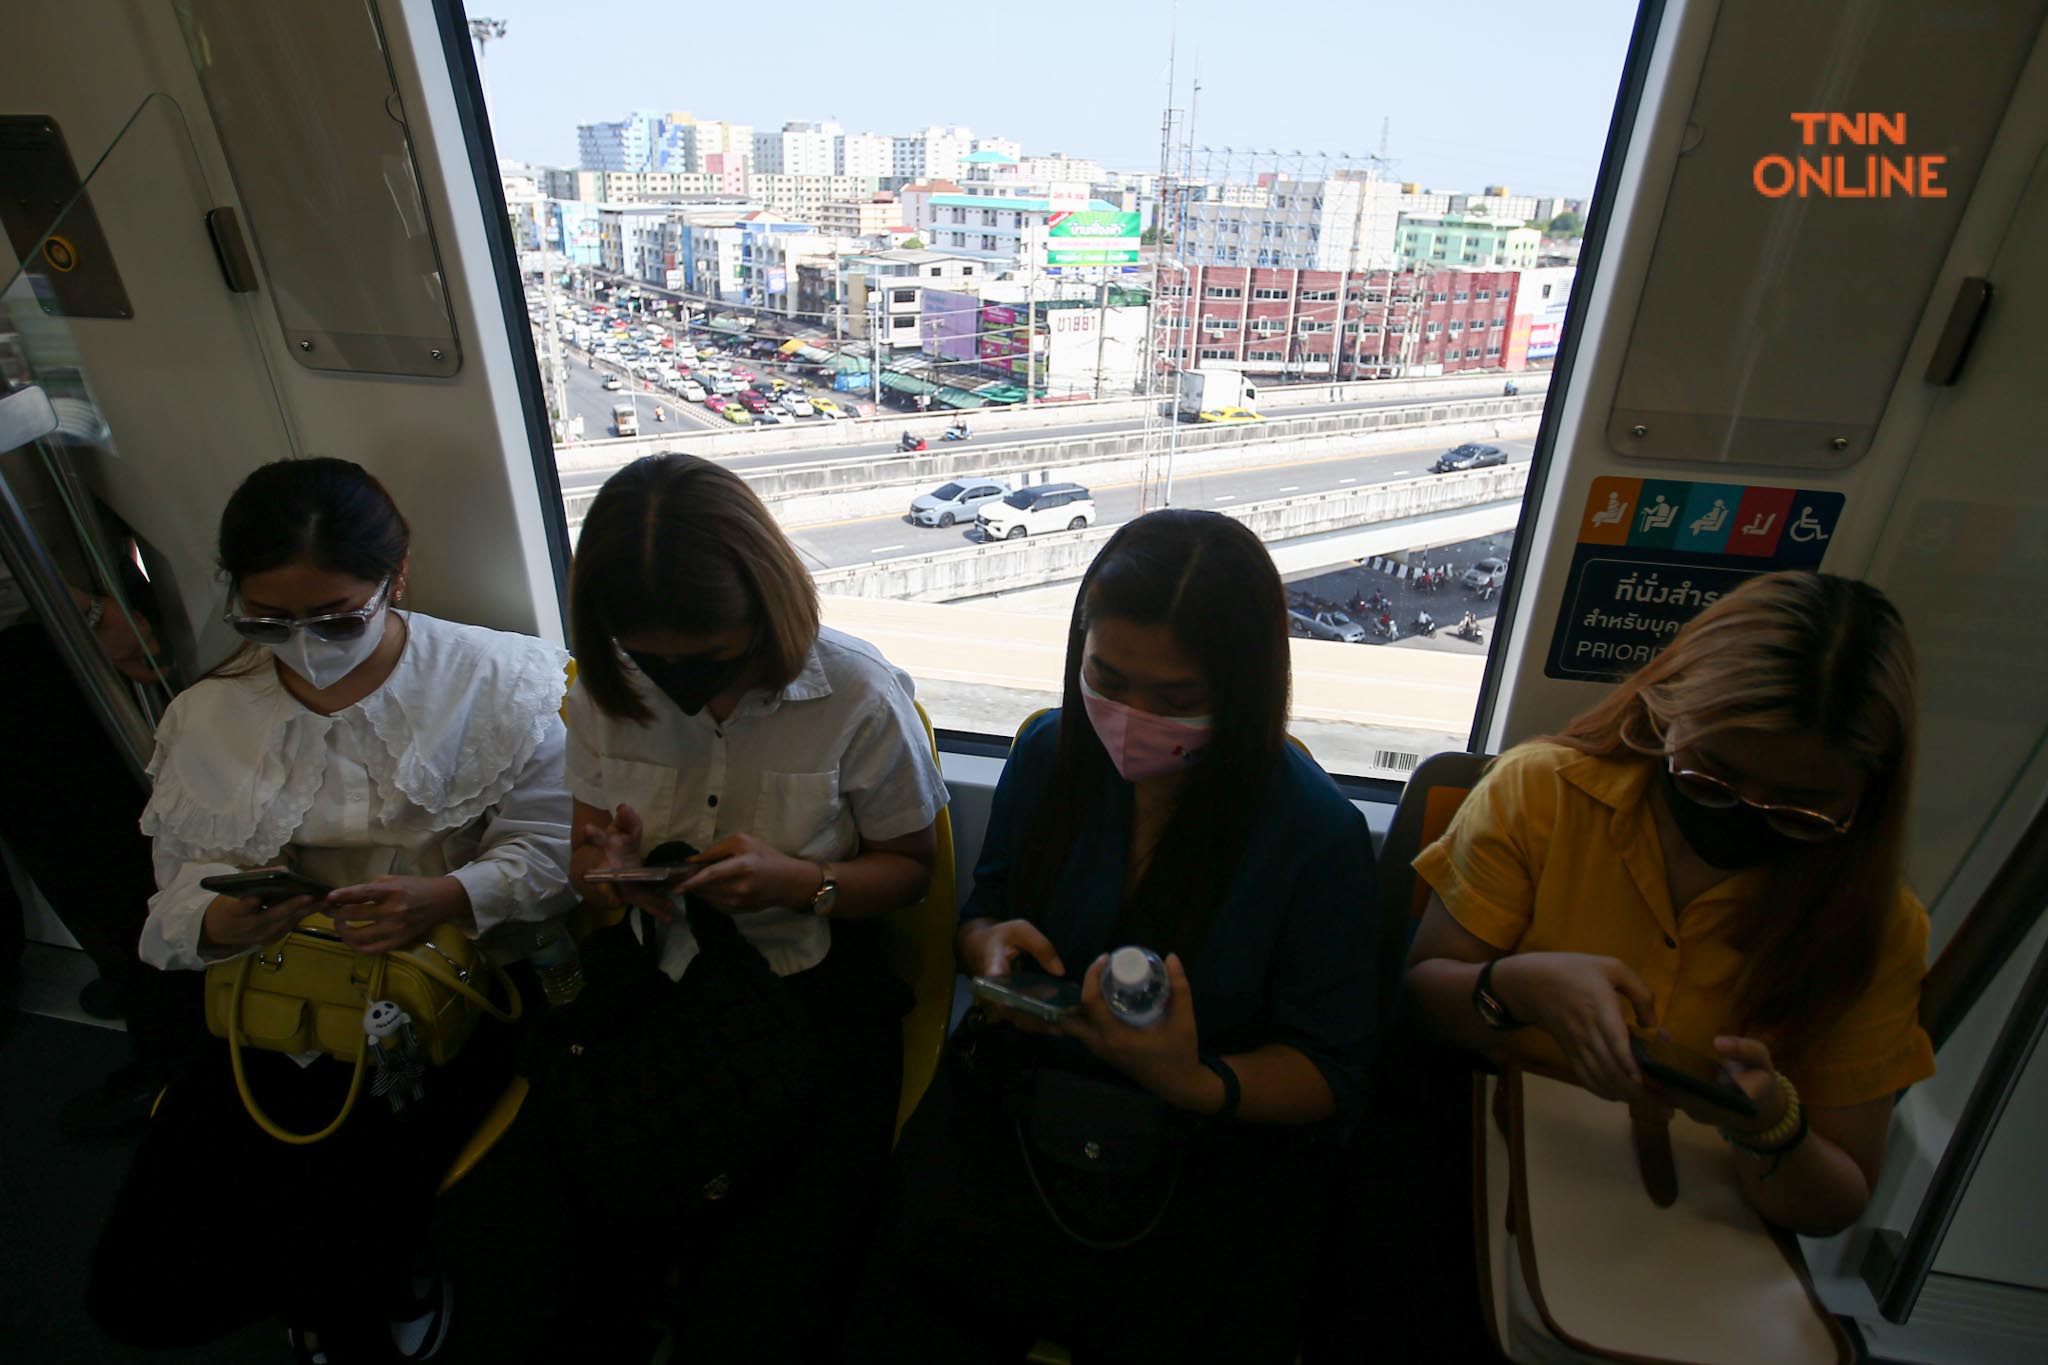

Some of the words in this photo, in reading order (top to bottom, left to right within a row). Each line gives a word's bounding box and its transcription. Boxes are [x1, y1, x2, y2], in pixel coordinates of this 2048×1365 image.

[1615, 571, 1720, 608] ที่นั่งสำร
[1583, 608, 1686, 639] สำหรับบุค
